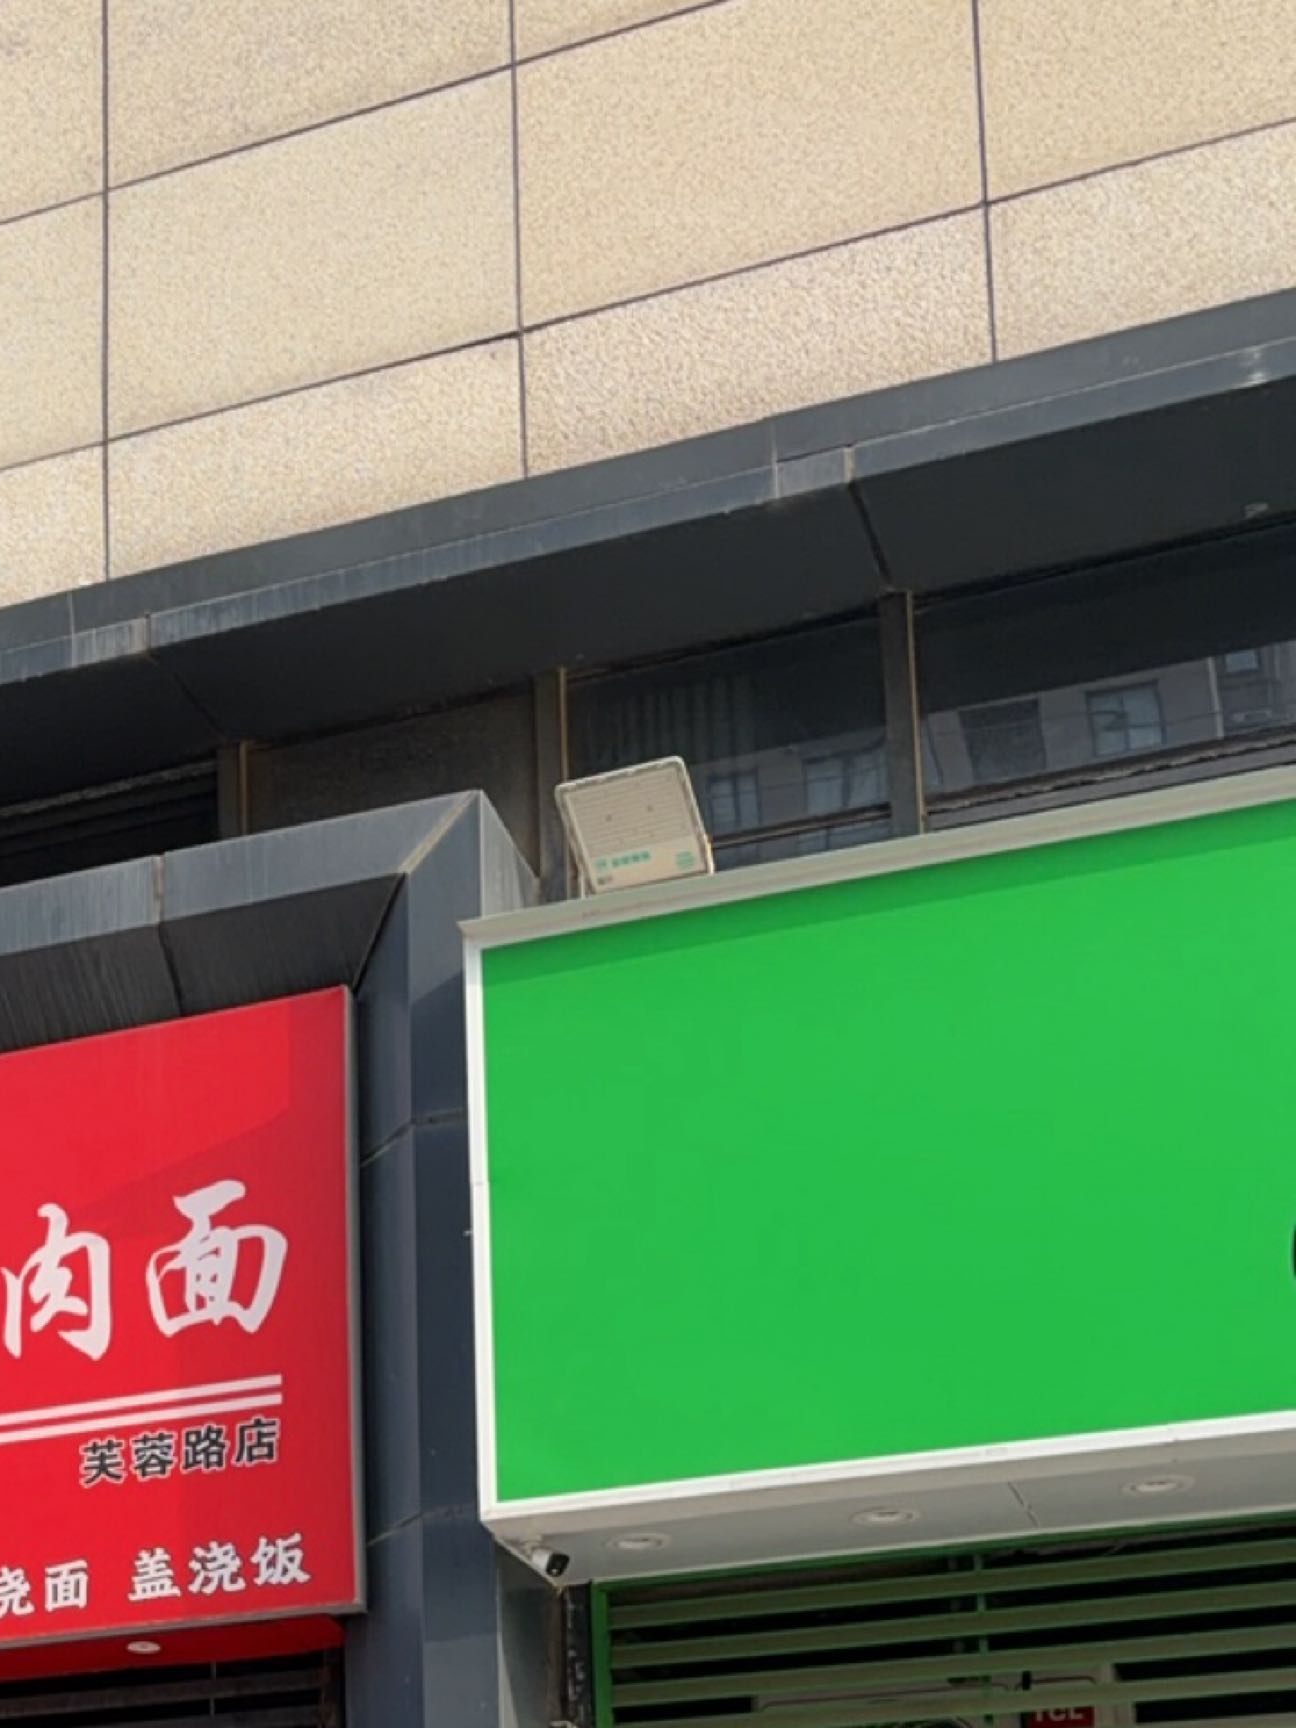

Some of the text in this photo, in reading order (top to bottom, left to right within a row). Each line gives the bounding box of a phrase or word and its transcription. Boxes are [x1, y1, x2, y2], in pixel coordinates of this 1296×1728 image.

[79, 1414, 280, 1490] 芙蓉路店
[127, 1532, 312, 1603] 盖浇饭
